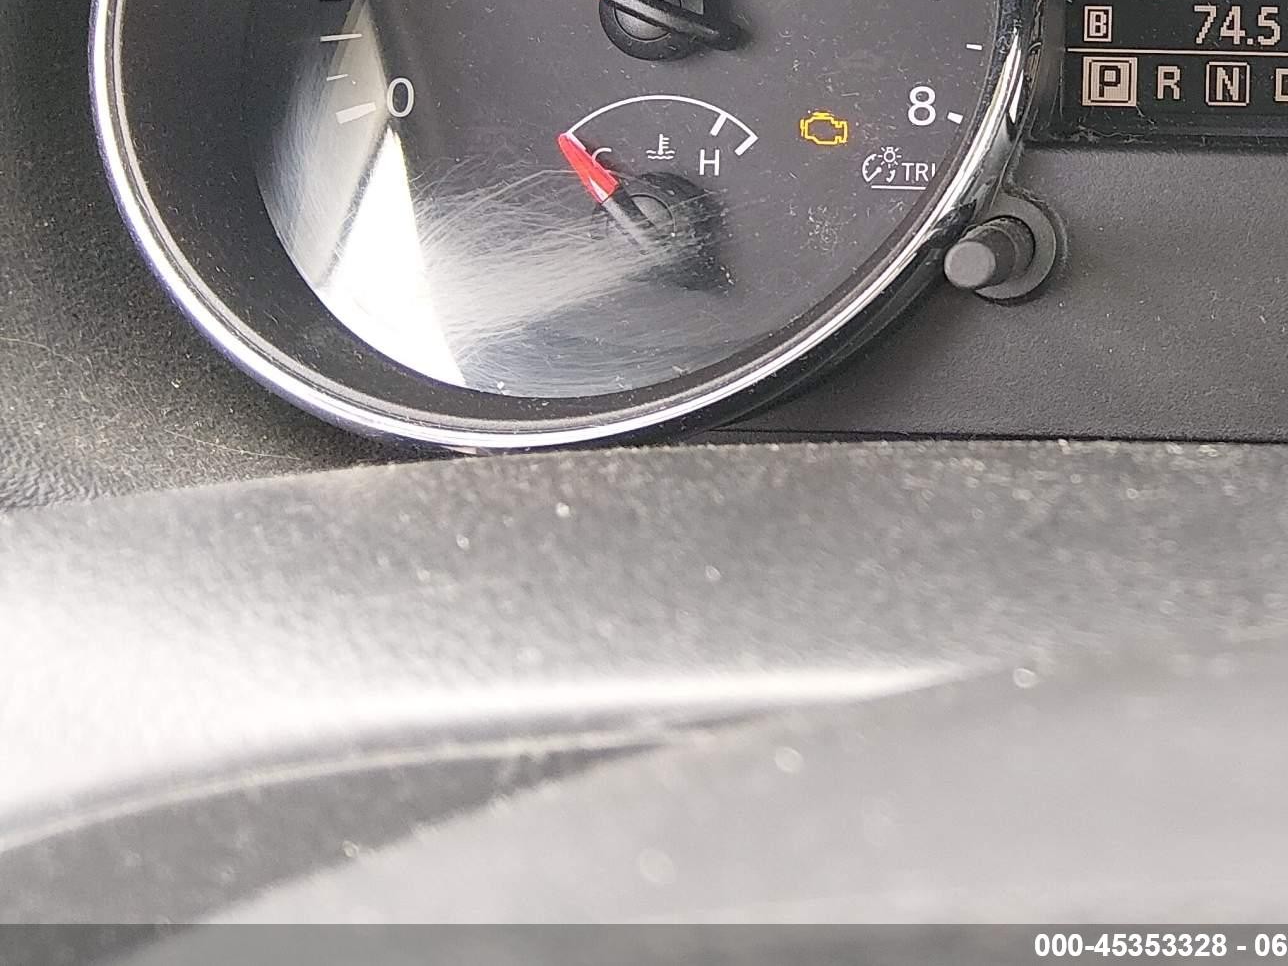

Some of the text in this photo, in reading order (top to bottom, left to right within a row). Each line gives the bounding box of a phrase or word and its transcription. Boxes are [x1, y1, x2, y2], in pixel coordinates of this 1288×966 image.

[1089, 11, 1107, 37] B
[1194, 4, 1281, 46] 74.5
[386, 77, 416, 118] 0
[1098, 64, 1122, 98] P
[1157, 65, 1181, 100] R
[1216, 67, 1240, 101] N
[907, 86, 937, 126] 8
[699, 149, 720, 176] H
